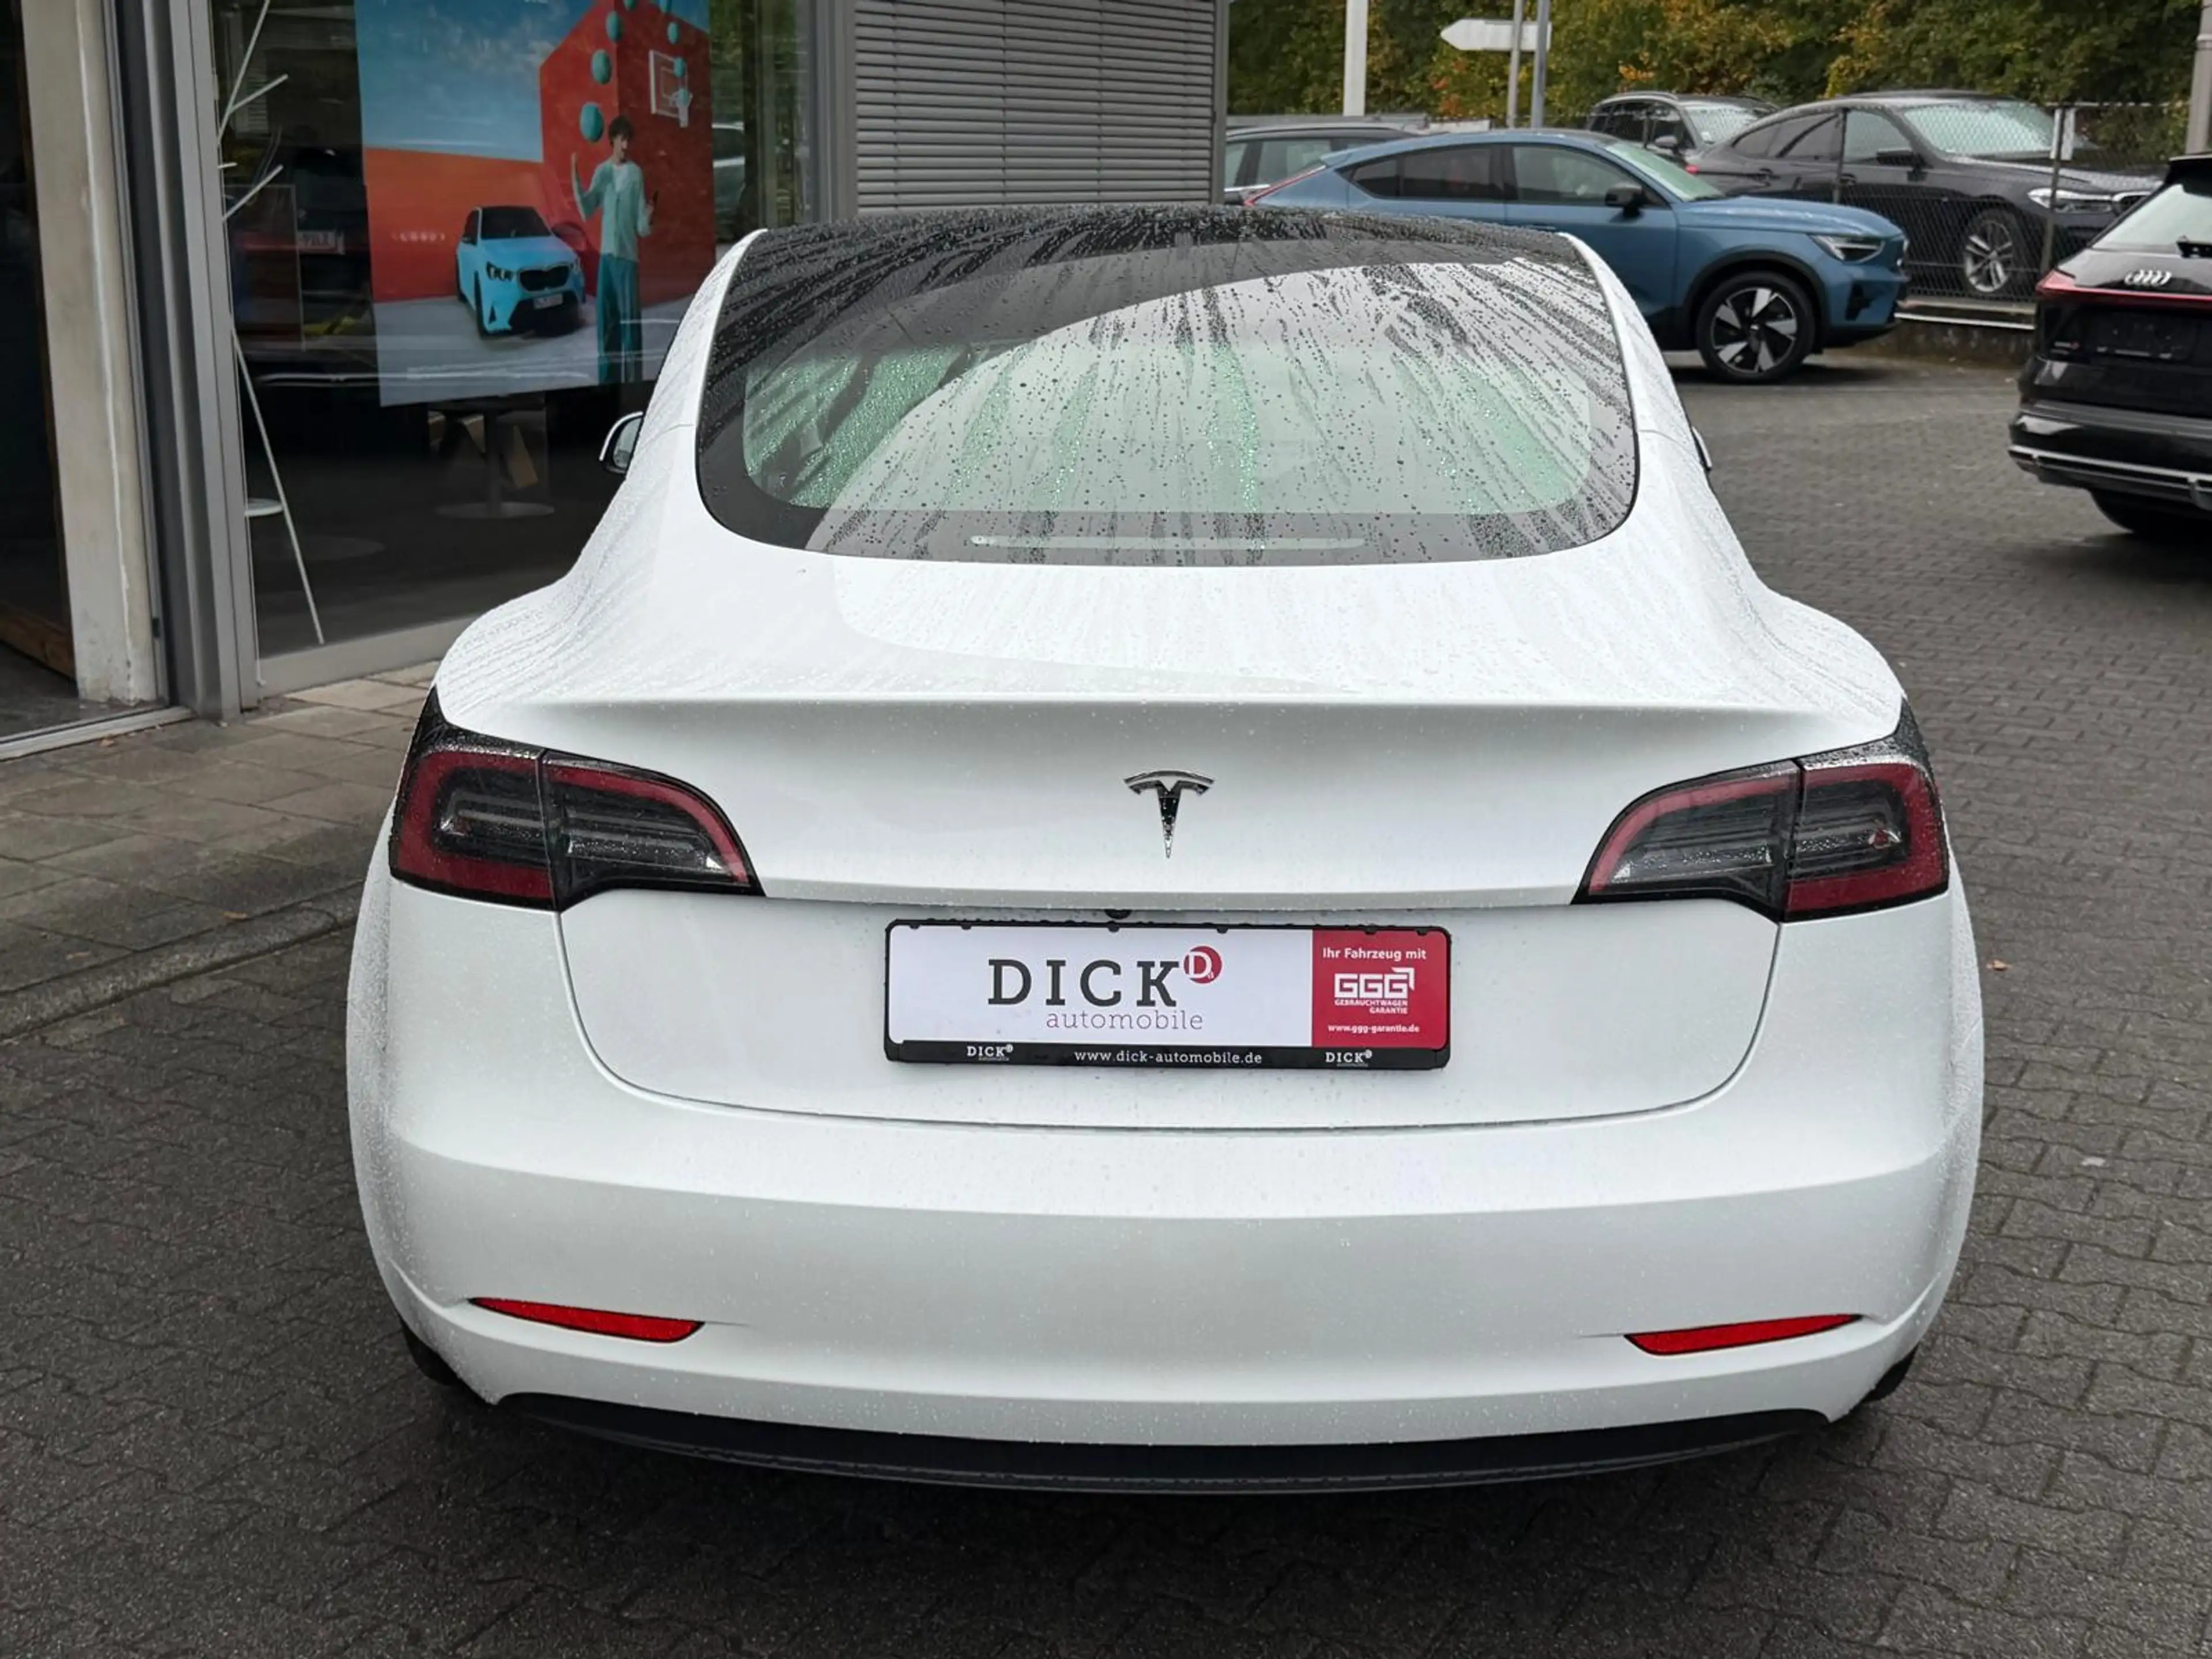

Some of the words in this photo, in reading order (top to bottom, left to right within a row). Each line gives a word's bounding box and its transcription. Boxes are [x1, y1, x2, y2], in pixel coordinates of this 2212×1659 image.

[1323, 947, 1340, 959] Ihr
[1344, 948, 1402, 961] Fahrzeug
[1406, 948, 1427, 960] mit
[988, 959, 1179, 1007] DICK
[1334, 973, 1408, 998] GGG
[1046, 1009, 1203, 1031] automobile
[1327, 1024, 1421, 1033] www.ggg-garantie.de
[1074, 1050, 1262, 1064] www.dick-automobile.de
